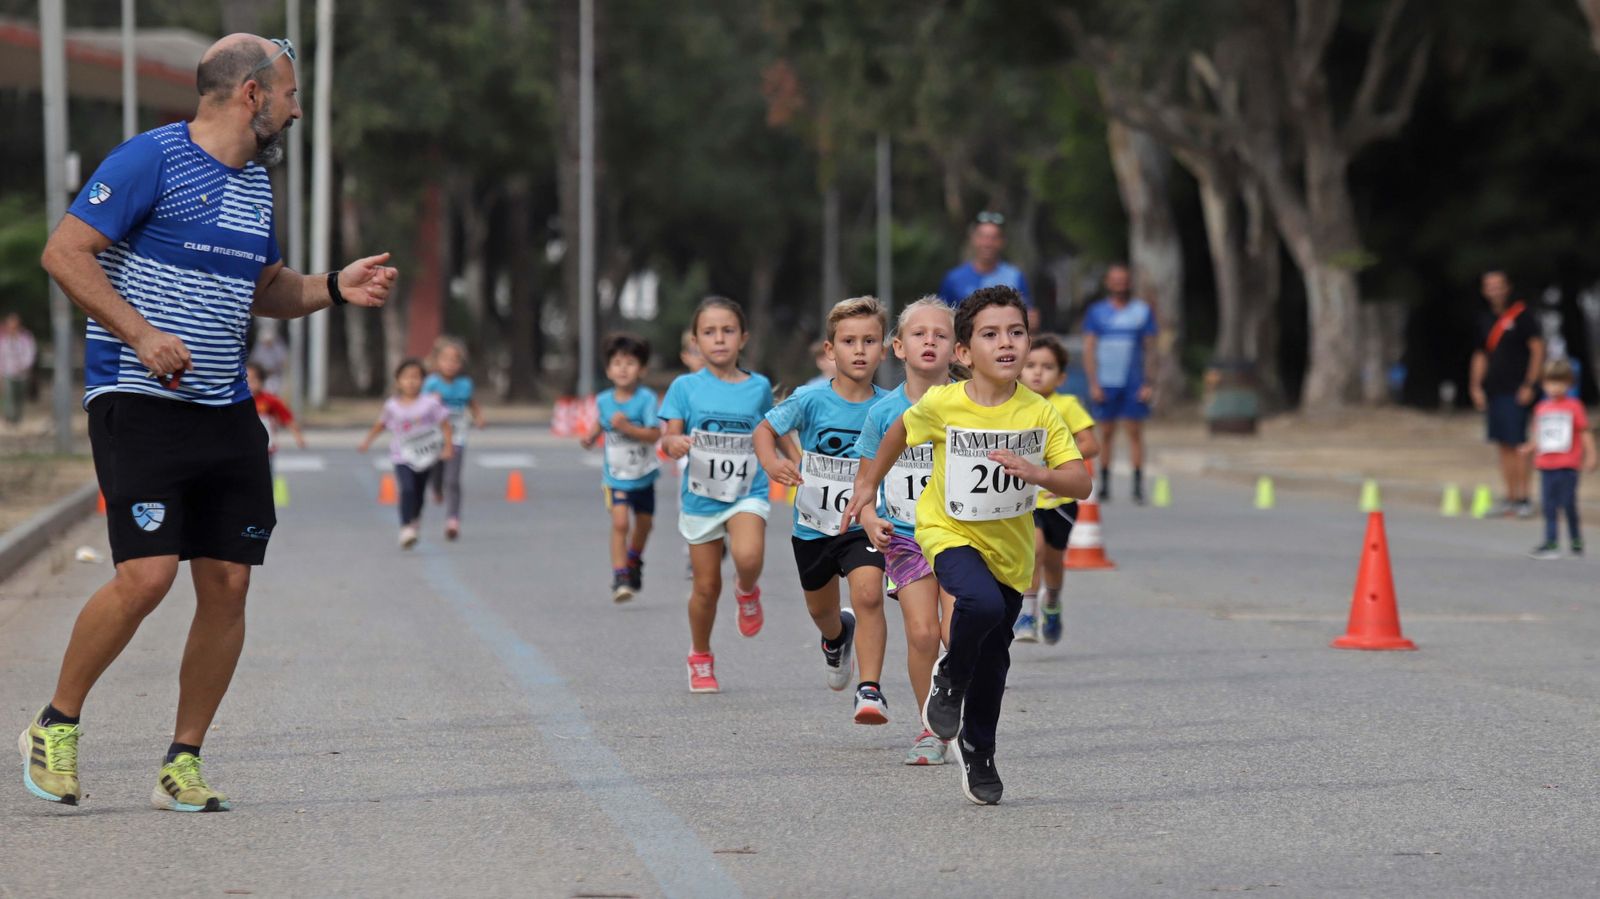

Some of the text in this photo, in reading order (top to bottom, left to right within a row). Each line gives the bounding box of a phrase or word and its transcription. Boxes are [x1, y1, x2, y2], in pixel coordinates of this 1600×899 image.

[183, 241, 211, 252] CLUB
[212, 246, 254, 260] ATLETISMO
[968, 431, 1040, 449] MILLA
[709, 459, 748, 481] 194
[818, 485, 853, 514] 16
